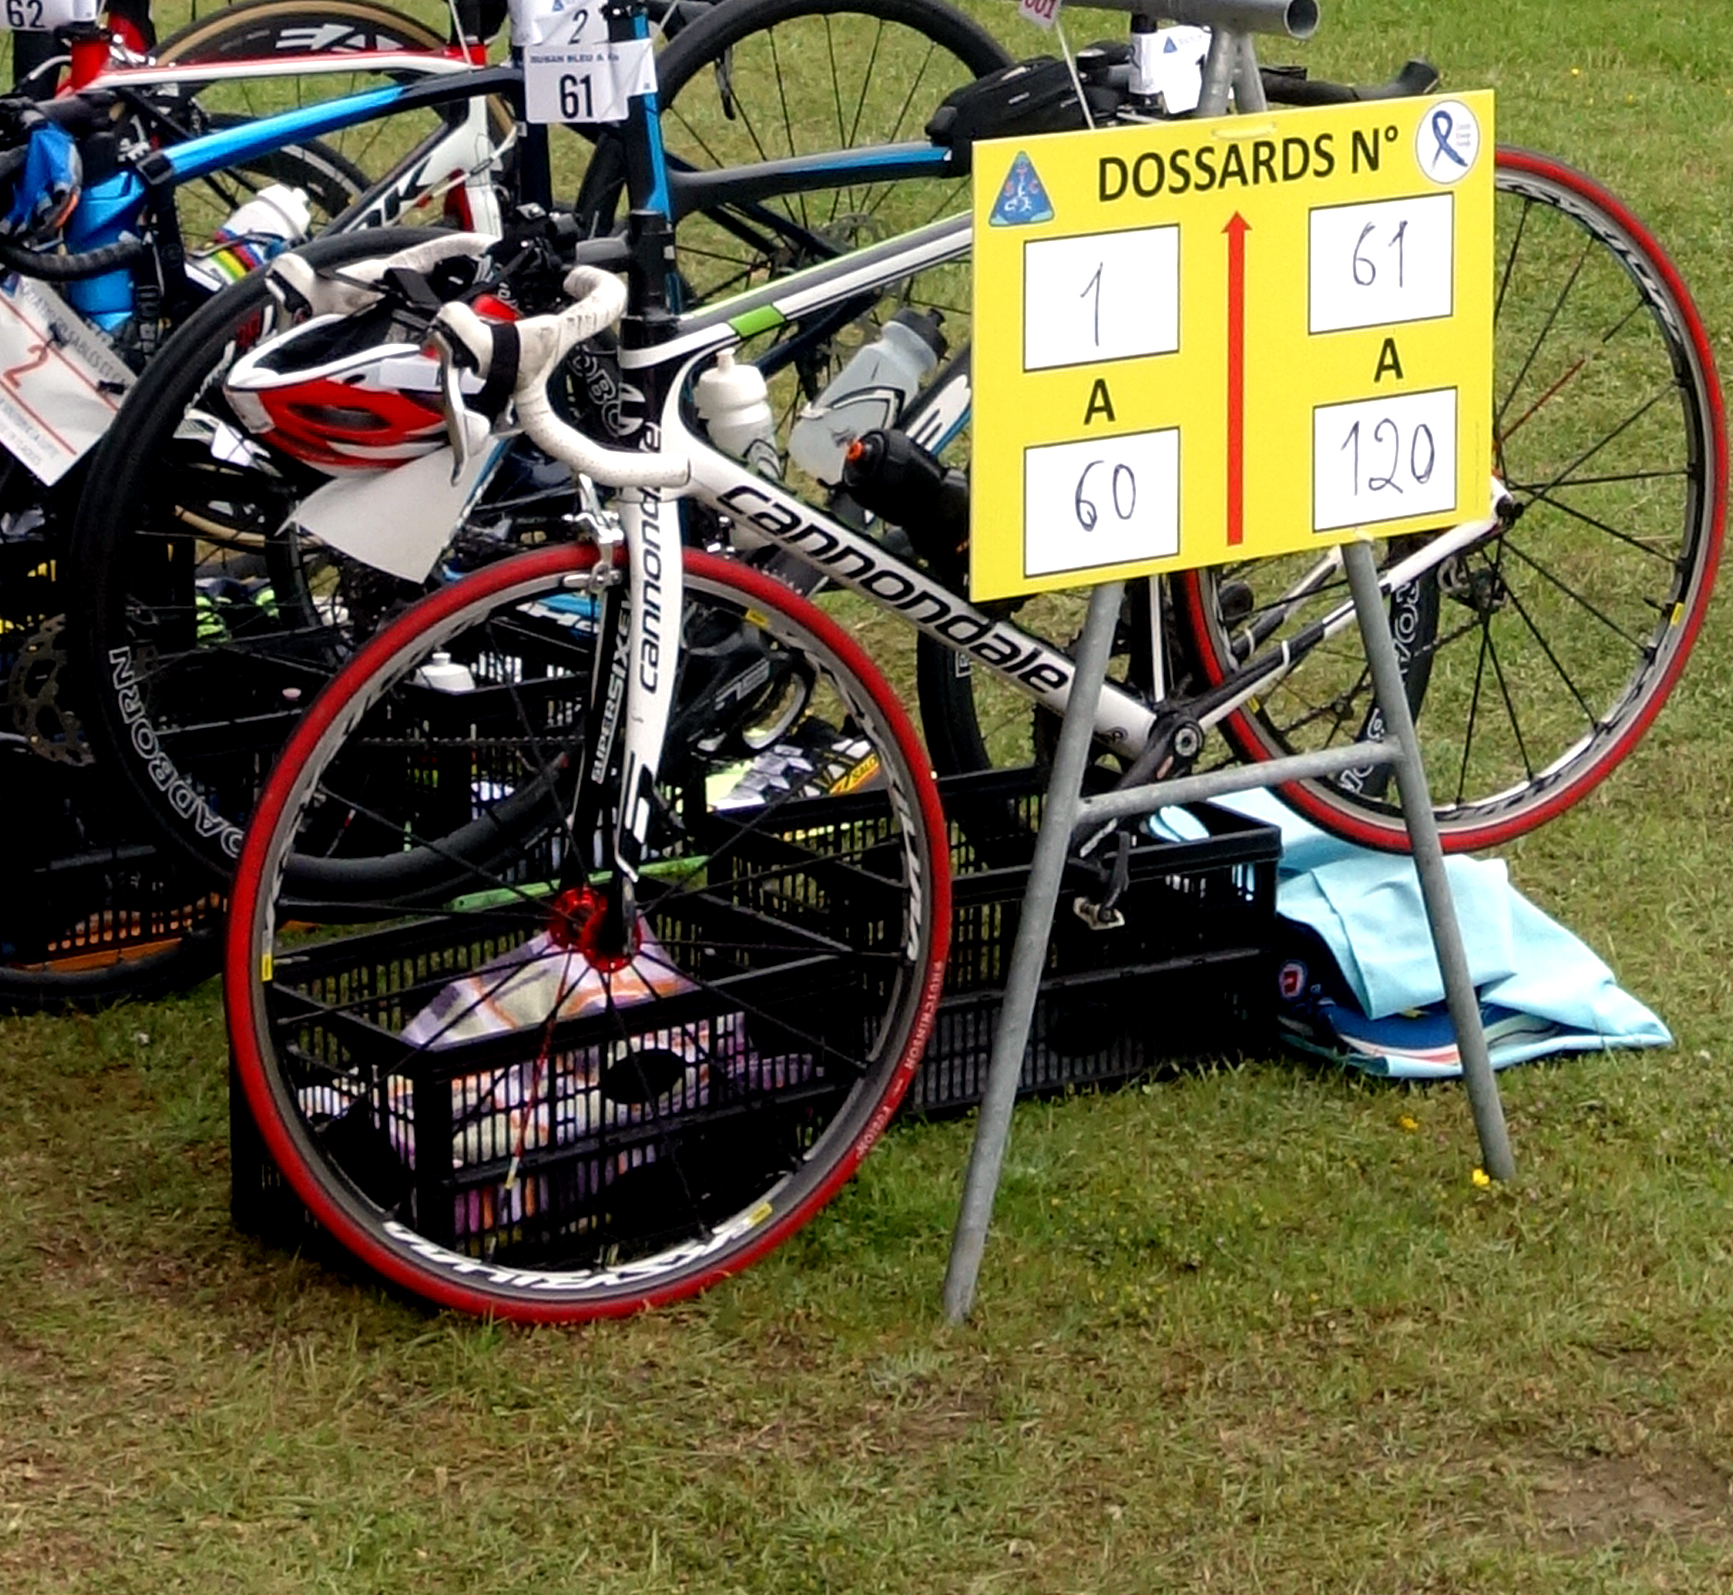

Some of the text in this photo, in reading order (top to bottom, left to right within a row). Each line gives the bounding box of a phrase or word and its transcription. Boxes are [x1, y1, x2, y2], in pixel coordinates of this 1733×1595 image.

[568, 8, 590, 46] 2
[559, 73, 593, 119] 61
[1098, 132, 1336, 202] DOSSARDS
[1351, 125, 1398, 175] N°
[1352, 219, 1406, 289] 61
[1080, 262, 1105, 347] 1
[5, 345, 49, 389] 2
[64, 327, 104, 369] SABLES
[1373, 337, 1405, 384] A
[1083, 378, 1116, 426] A
[1340, 416, 1435, 498] 120
[1074, 459, 1138, 533] 60
[636, 421, 663, 694] cannonde
[717, 484, 1070, 693] cannondale
